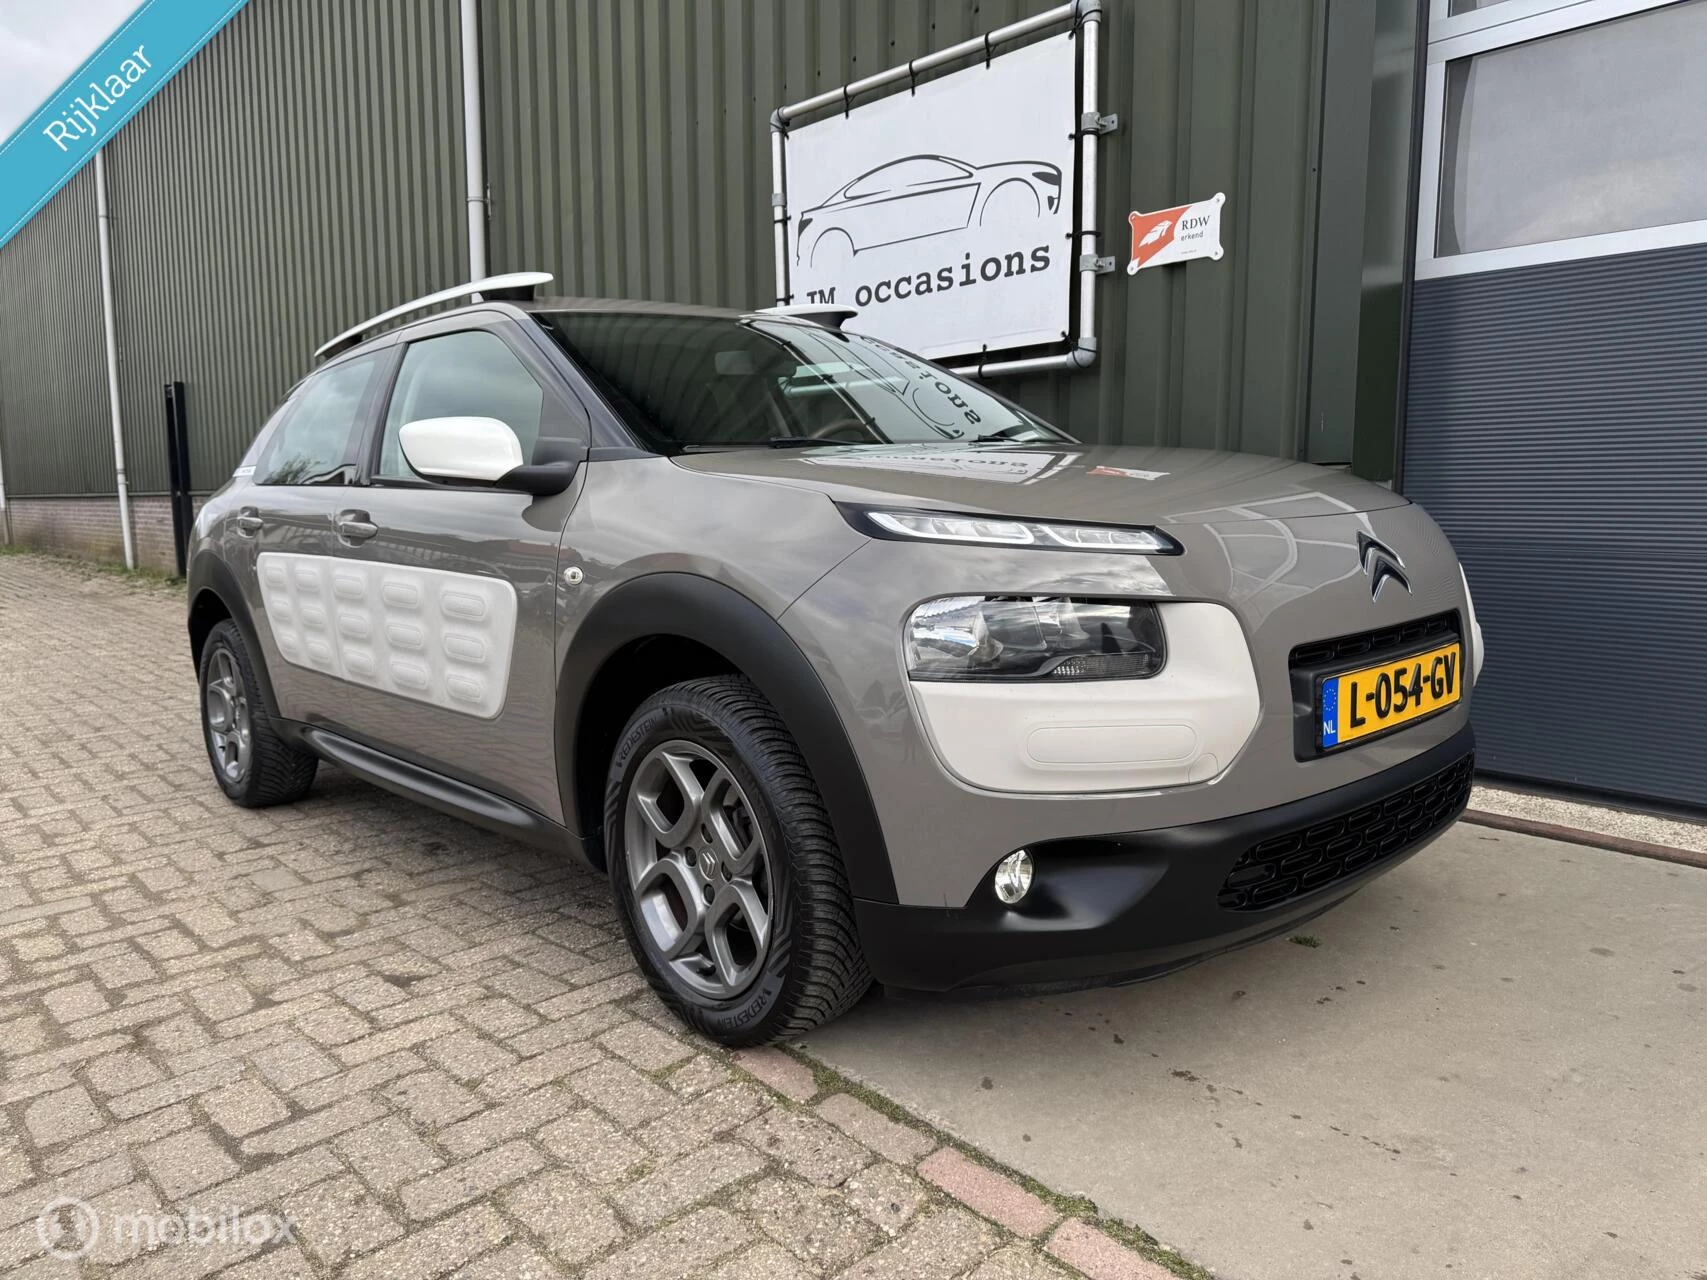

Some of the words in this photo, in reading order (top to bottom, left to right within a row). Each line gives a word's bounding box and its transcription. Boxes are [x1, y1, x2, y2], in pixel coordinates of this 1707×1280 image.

[1182, 215, 1211, 231] RDW
[854, 245, 1051, 307] occasions
[1350, 652, 1457, 728] L-054-GV
[1323, 720, 1336, 735] NL
